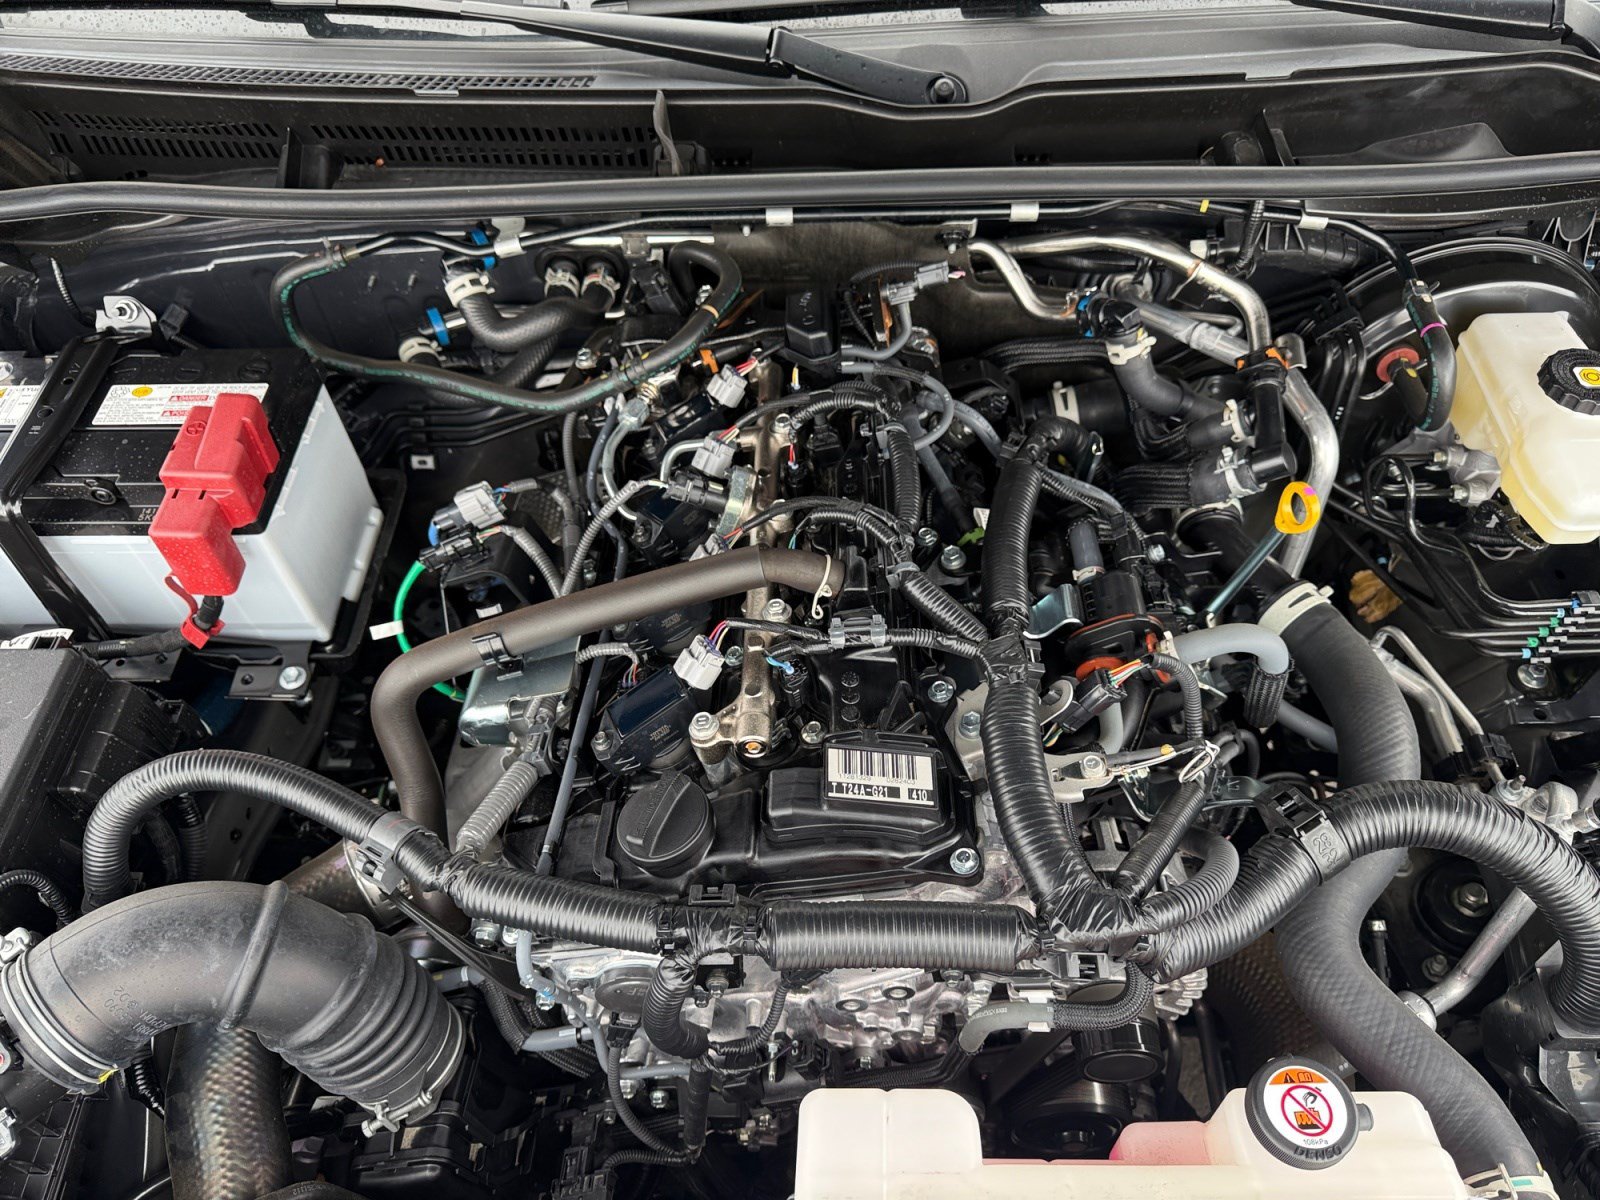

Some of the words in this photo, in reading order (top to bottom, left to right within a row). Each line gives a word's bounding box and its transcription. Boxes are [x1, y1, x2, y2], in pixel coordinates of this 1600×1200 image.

[842, 783, 888, 798] T24A-G21
[911, 790, 928, 801] 410
[1303, 1138, 1329, 1146] 108kPa
[1293, 1144, 1342, 1162] DENSO
